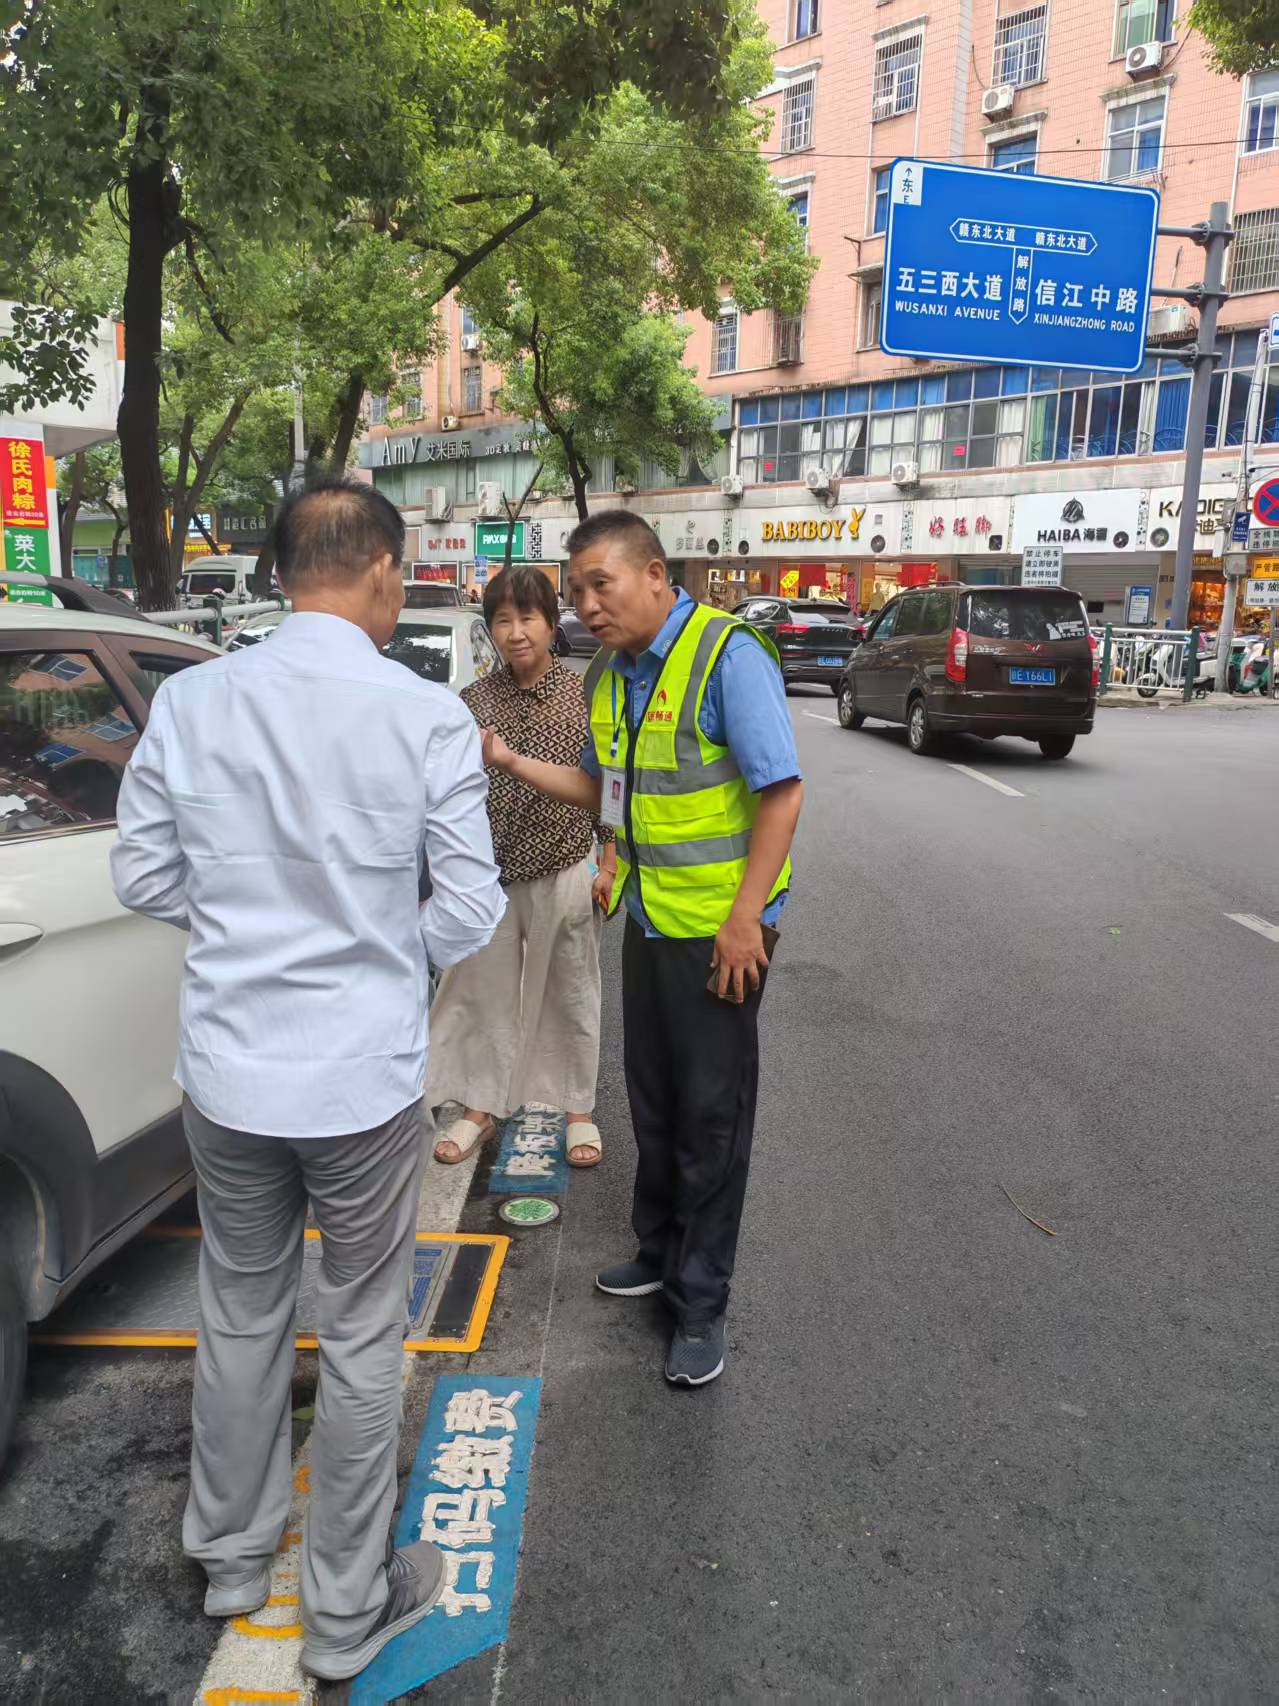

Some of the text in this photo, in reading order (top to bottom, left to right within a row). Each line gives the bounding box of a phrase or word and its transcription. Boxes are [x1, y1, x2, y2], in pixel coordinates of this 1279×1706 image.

[902, 178, 913, 192] 东
[903, 194, 910, 204] E
[959, 222, 1016, 242] 赣东北大道
[1035, 231, 1087, 251] 赣东北大道
[896, 267, 1003, 300] 五三西大道
[1012, 254, 1029, 312] 解放路
[1035, 279, 1138, 314] 信江中路
[895, 300, 1001, 321] WUSANXI AVENUE
[1033, 313, 1135, 333] XINJIANGZHONG ROAD
[425, 440, 471, 461] 艾米国际
[8, 441, 35, 509] 徐氏肉粽
[762, 520, 846, 542] BABIBOY
[1037, 529, 1081, 542] HAIBA
[14, 534, 37, 573] 菜大
[1026, 550, 1060, 558] 禁止停车
